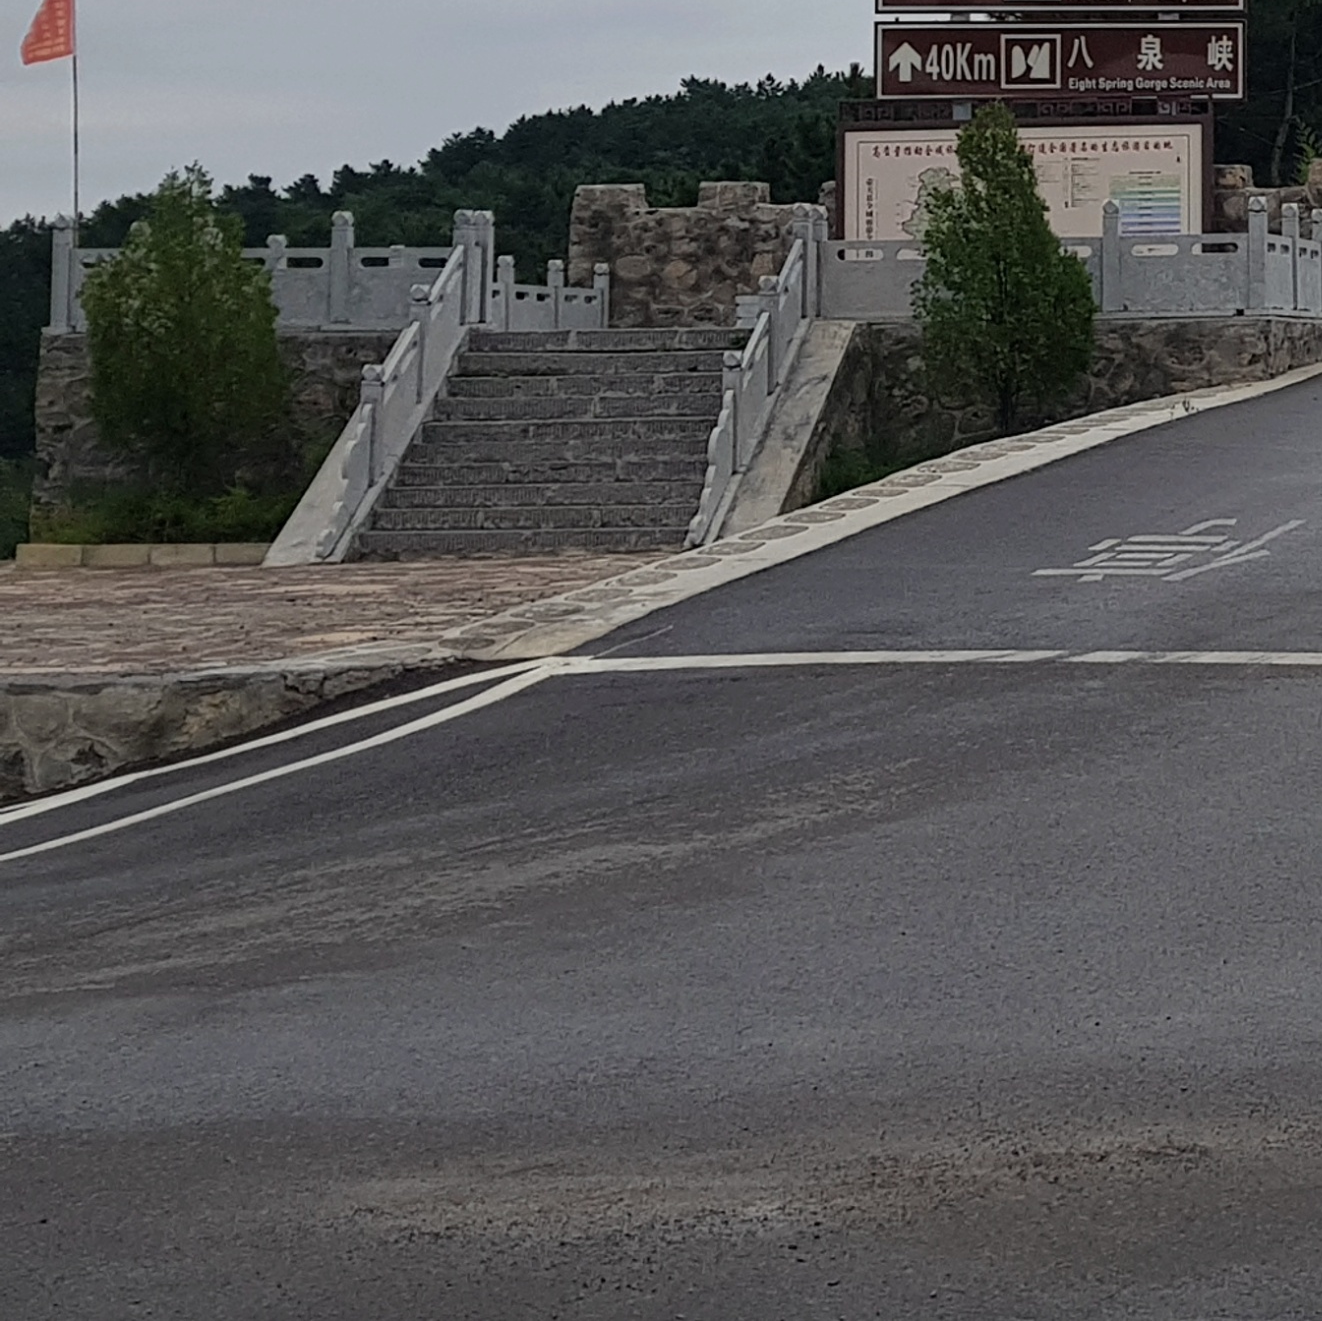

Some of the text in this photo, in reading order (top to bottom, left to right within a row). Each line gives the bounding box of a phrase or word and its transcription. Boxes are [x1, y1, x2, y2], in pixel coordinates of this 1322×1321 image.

[925, 41, 996, 81] 40Km
[1067, 34, 1234, 73] 八泉峡
[1068, 77, 1231, 91] Eight Spring Gorge Scenic Area
